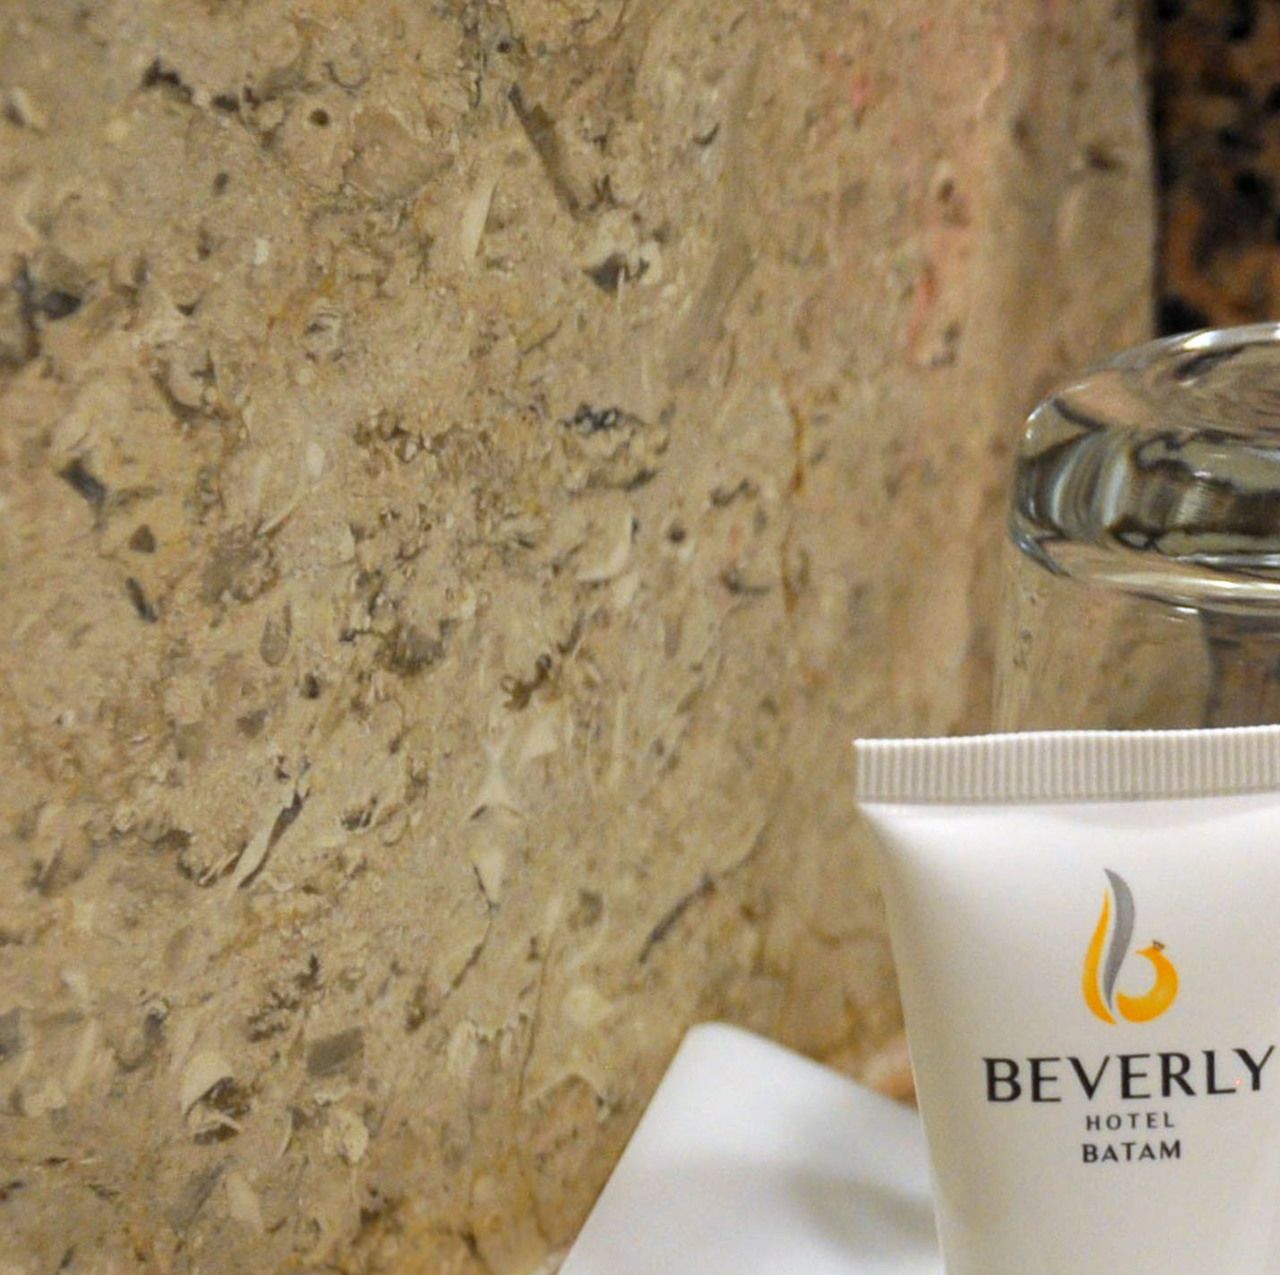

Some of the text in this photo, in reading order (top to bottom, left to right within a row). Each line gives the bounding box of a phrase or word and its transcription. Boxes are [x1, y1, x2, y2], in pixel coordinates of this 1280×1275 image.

[982, 1045, 1277, 1103] BEVERLY
[1086, 1112, 1176, 1132] HOTEL
[1082, 1139, 1182, 1164] BATAM
